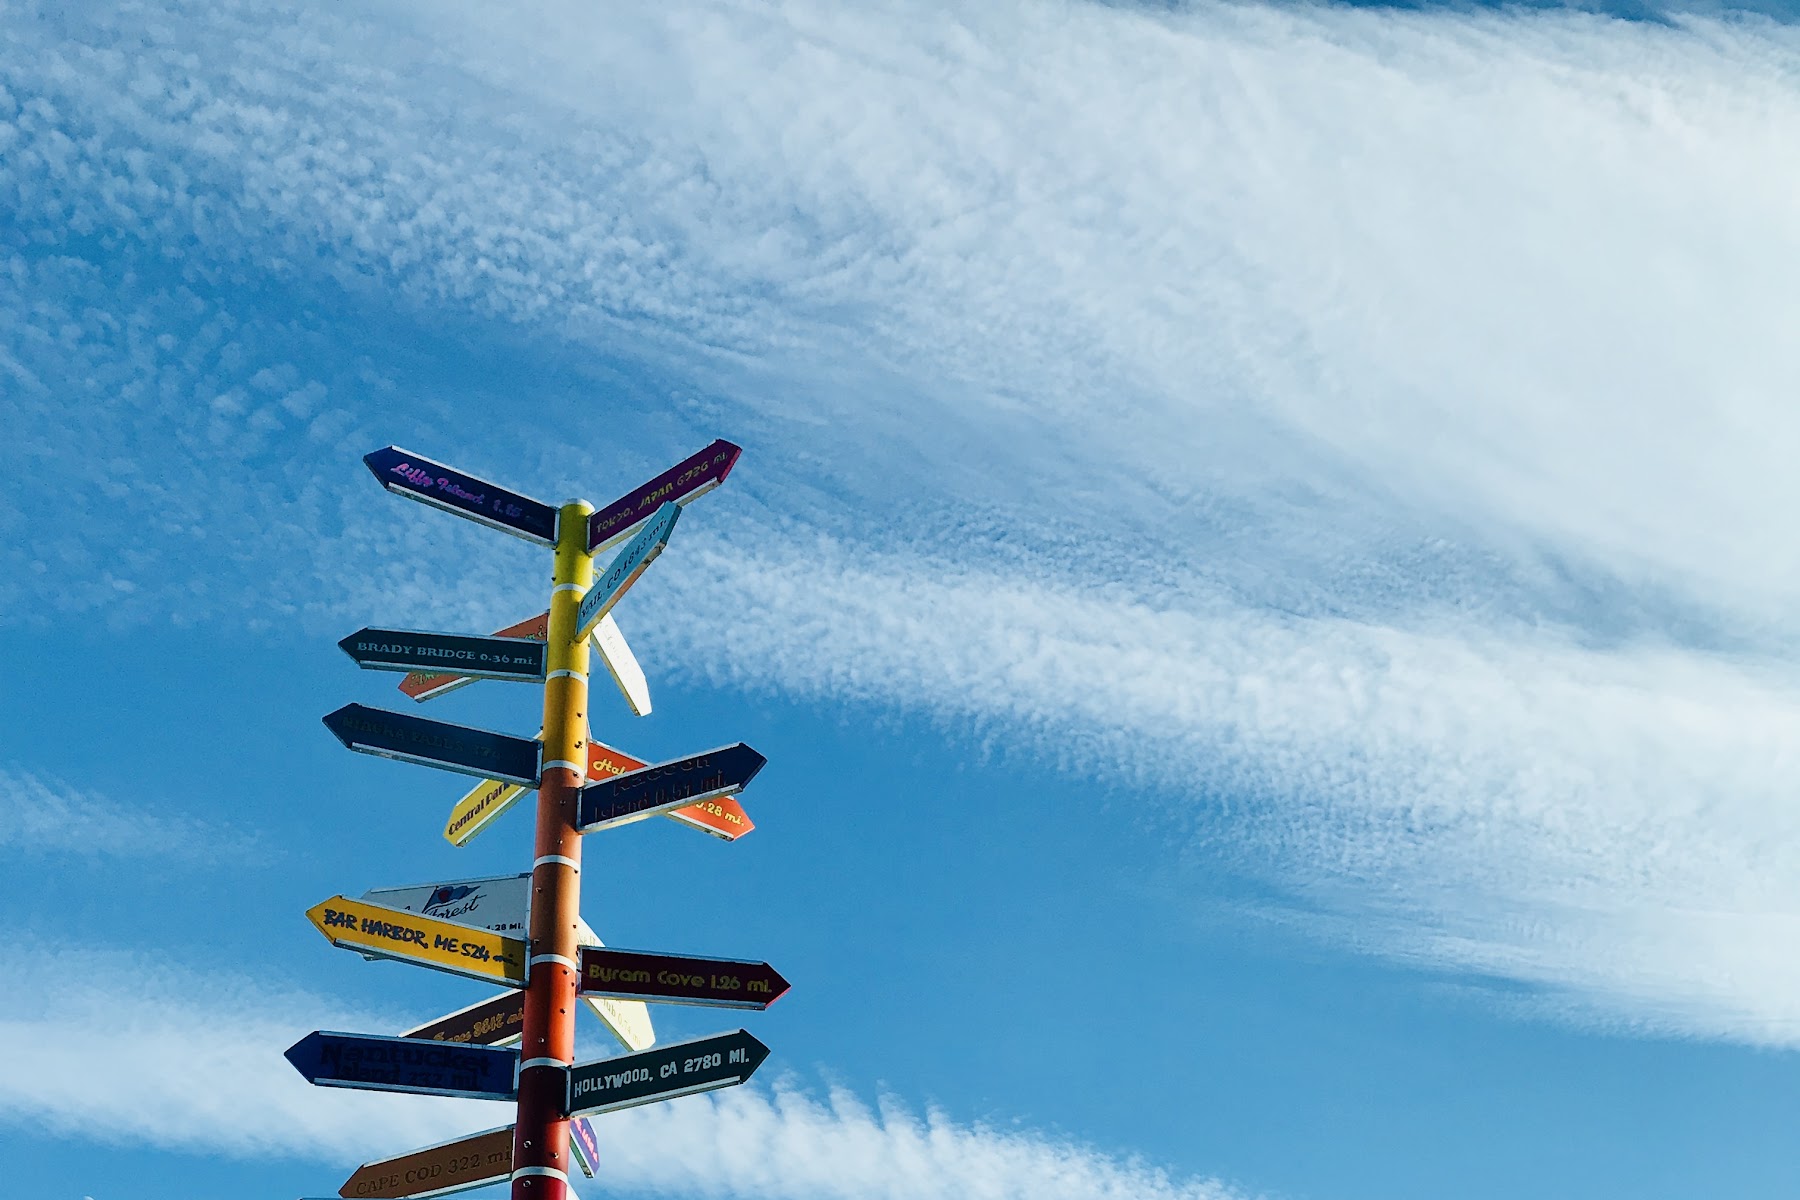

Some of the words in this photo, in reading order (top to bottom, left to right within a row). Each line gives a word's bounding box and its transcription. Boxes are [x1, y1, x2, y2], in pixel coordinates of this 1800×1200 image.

[437, 477, 486, 505] Island
[638, 482, 674, 511] JAPAN
[607, 568, 620, 589] CO
[648, 515, 667, 541] mi.
[357, 641, 413, 655] BRADY
[416, 646, 477, 661] BRIDGE
[479, 652, 511, 664] 0.36
[512, 655, 537, 666] mi.
[411, 729, 464, 752] FALLS
[448, 797, 485, 836] Central
[724, 812, 745, 827] mi.
[323, 908, 358, 931] BAR
[361, 918, 429, 949] HARBOR,
[433, 934, 459, 953] ME
[460, 942, 490, 962] 524
[509, 922, 524, 930] MI.
[588, 963, 651, 984] Byram
[656, 970, 705, 988] Cove
[710, 974, 741, 990] 1.26
[747, 978, 773, 993] mi.
[321, 1043, 493, 1078] Nantucket
[574, 1068, 654, 1098] HOLLYWOOD,
[660, 1061, 678, 1079] CA
[683, 1053, 722, 1073] 2780
[728, 1047, 750, 1064] MI.
[356, 1174, 400, 1195] CAPE
[404, 1164, 442, 1184] COD
[447, 1153, 480, 1174] 322
